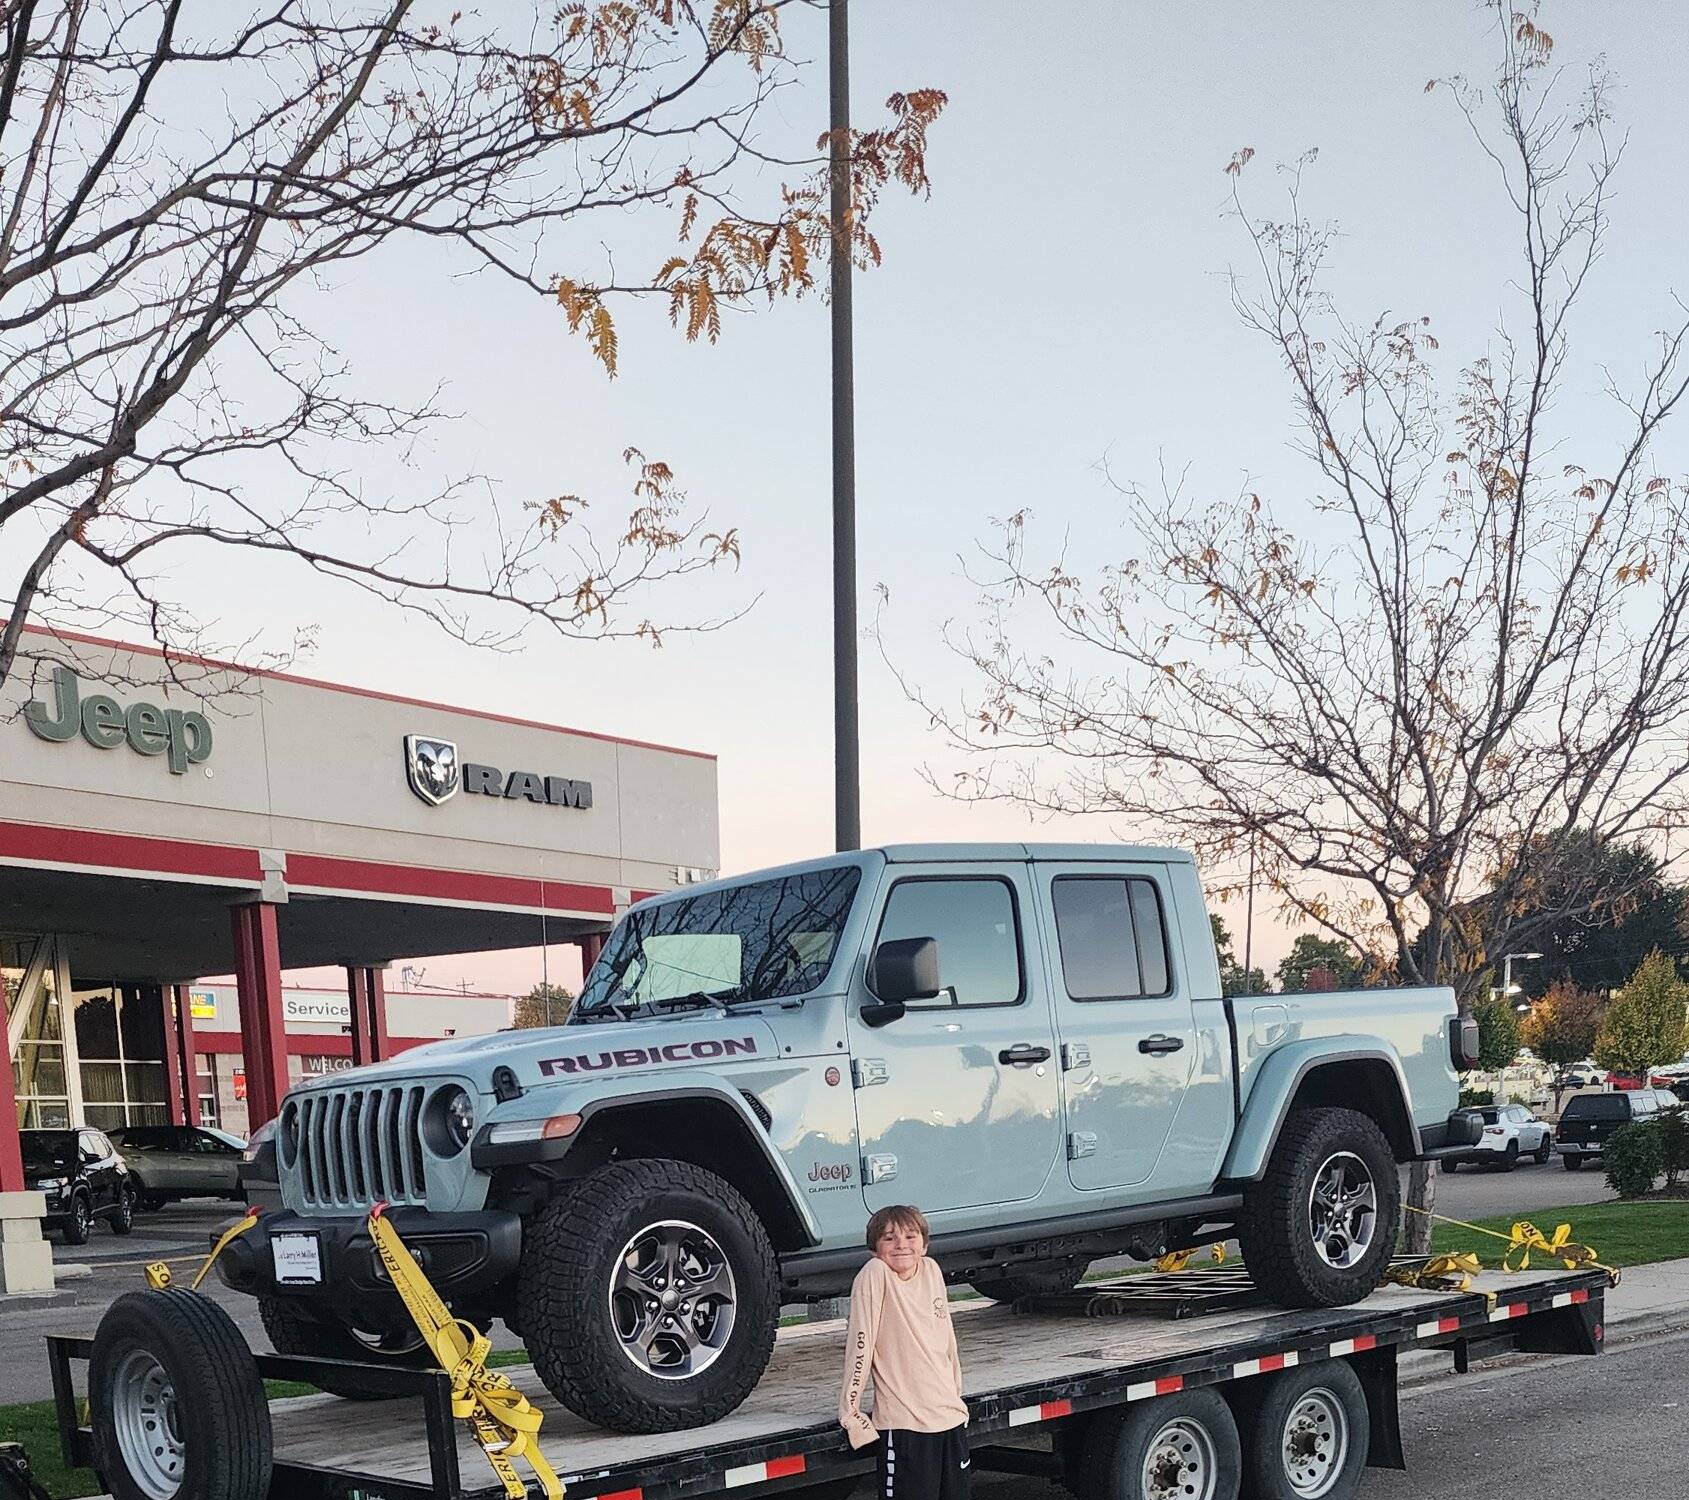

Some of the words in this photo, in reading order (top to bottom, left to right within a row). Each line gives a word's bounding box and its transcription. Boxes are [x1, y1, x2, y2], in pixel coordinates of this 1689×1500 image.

[24, 667, 213, 775] Jeep
[463, 763, 593, 809] RAM
[287, 1001, 349, 1016] Service
[538, 1037, 757, 1077] RUBICON
[808, 1162, 852, 1182] Jeep
[857, 1331, 866, 1350] GO
[852, 1354, 865, 1387] YOUR
